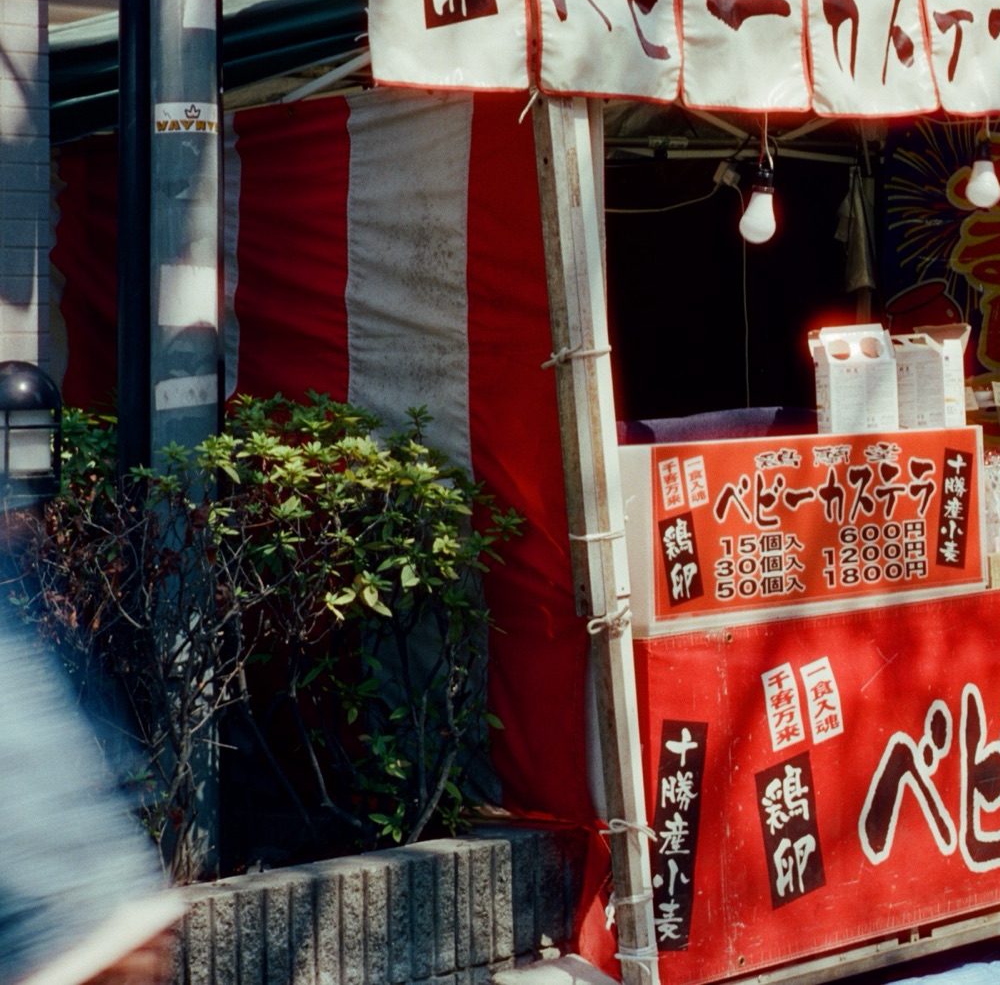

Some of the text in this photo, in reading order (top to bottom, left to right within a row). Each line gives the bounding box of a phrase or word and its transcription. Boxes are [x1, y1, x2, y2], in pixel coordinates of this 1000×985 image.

[713, 456, 937, 528] ベビーカステラ
[939, 453, 968, 563] 十勝産小麦
[663, 517, 698, 600] 鶏卵
[715, 541, 926, 579] 30個入 1200円
[720, 520, 925, 557] 15個入 600円
[716, 560, 928, 601] 50個入 1800円
[767, 670, 800, 745] 千客万来
[806, 666, 840, 735] 一食入魂
[653, 727, 699, 942] 十勝産小麦
[761, 764, 817, 898] 鶏卵
